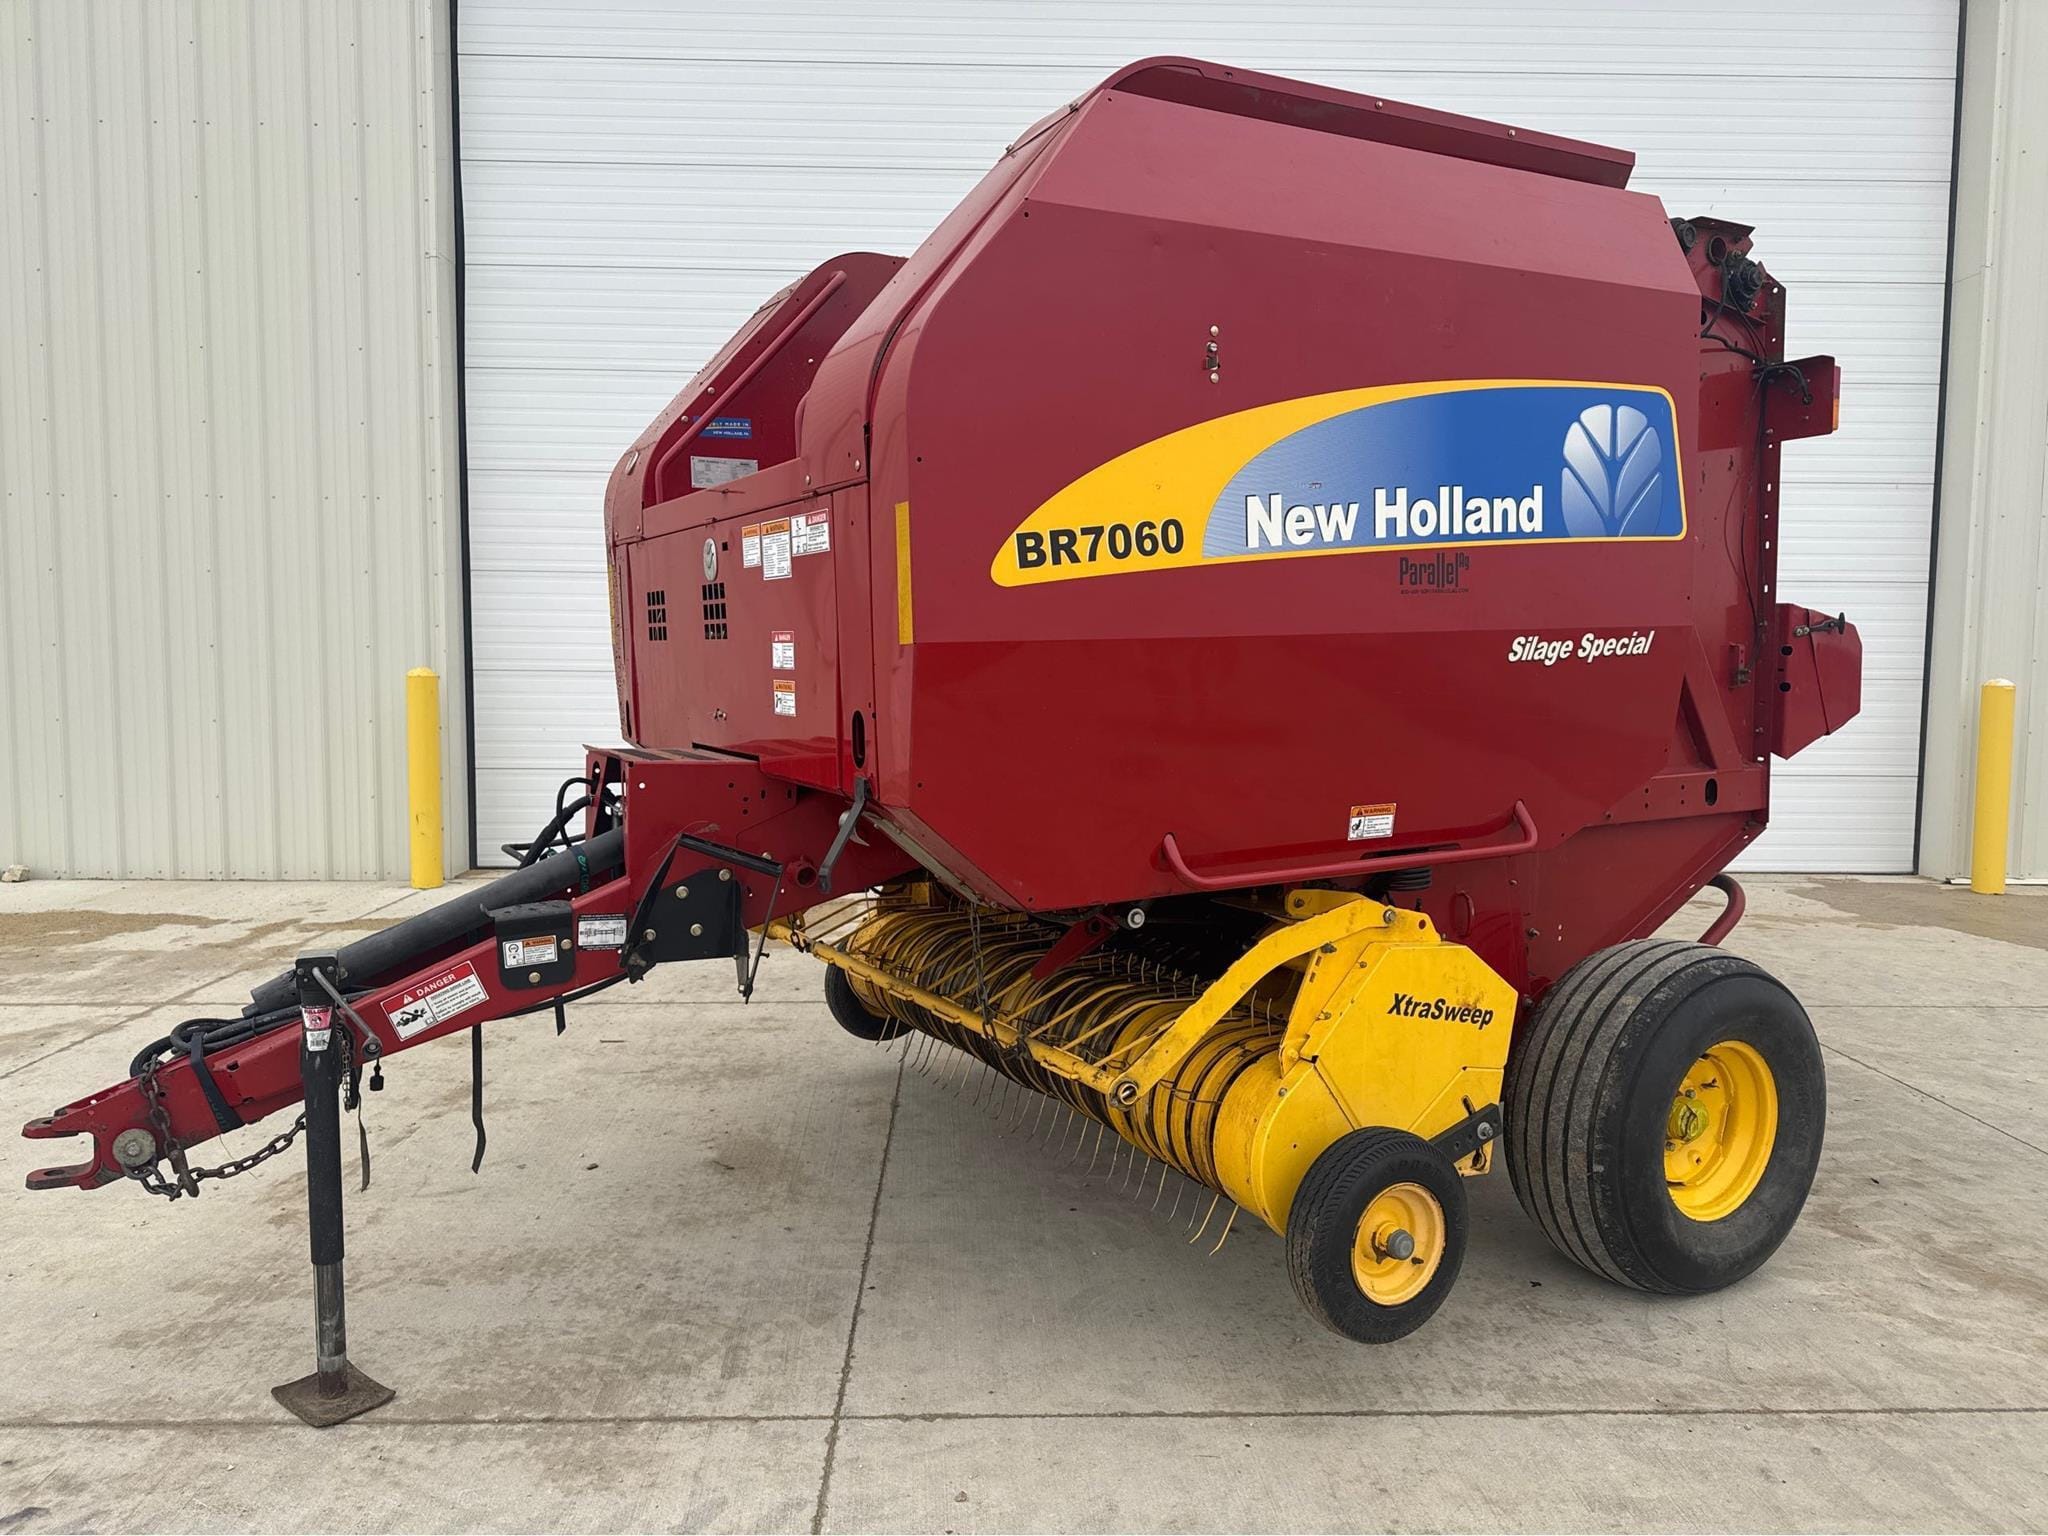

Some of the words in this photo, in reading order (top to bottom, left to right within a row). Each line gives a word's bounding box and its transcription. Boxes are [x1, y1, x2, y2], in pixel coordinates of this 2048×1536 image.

[1245, 493, 1360, 549] New
[1373, 485, 1544, 539] Holland
[1015, 518, 1185, 570] BR7060
[1399, 552, 1459, 588] Parallel
[1508, 633, 1574, 667] Silage
[1577, 630, 1656, 664] Special
[416, 973, 456, 997] DANGER
[1387, 993, 1494, 1030] XtraSweep
